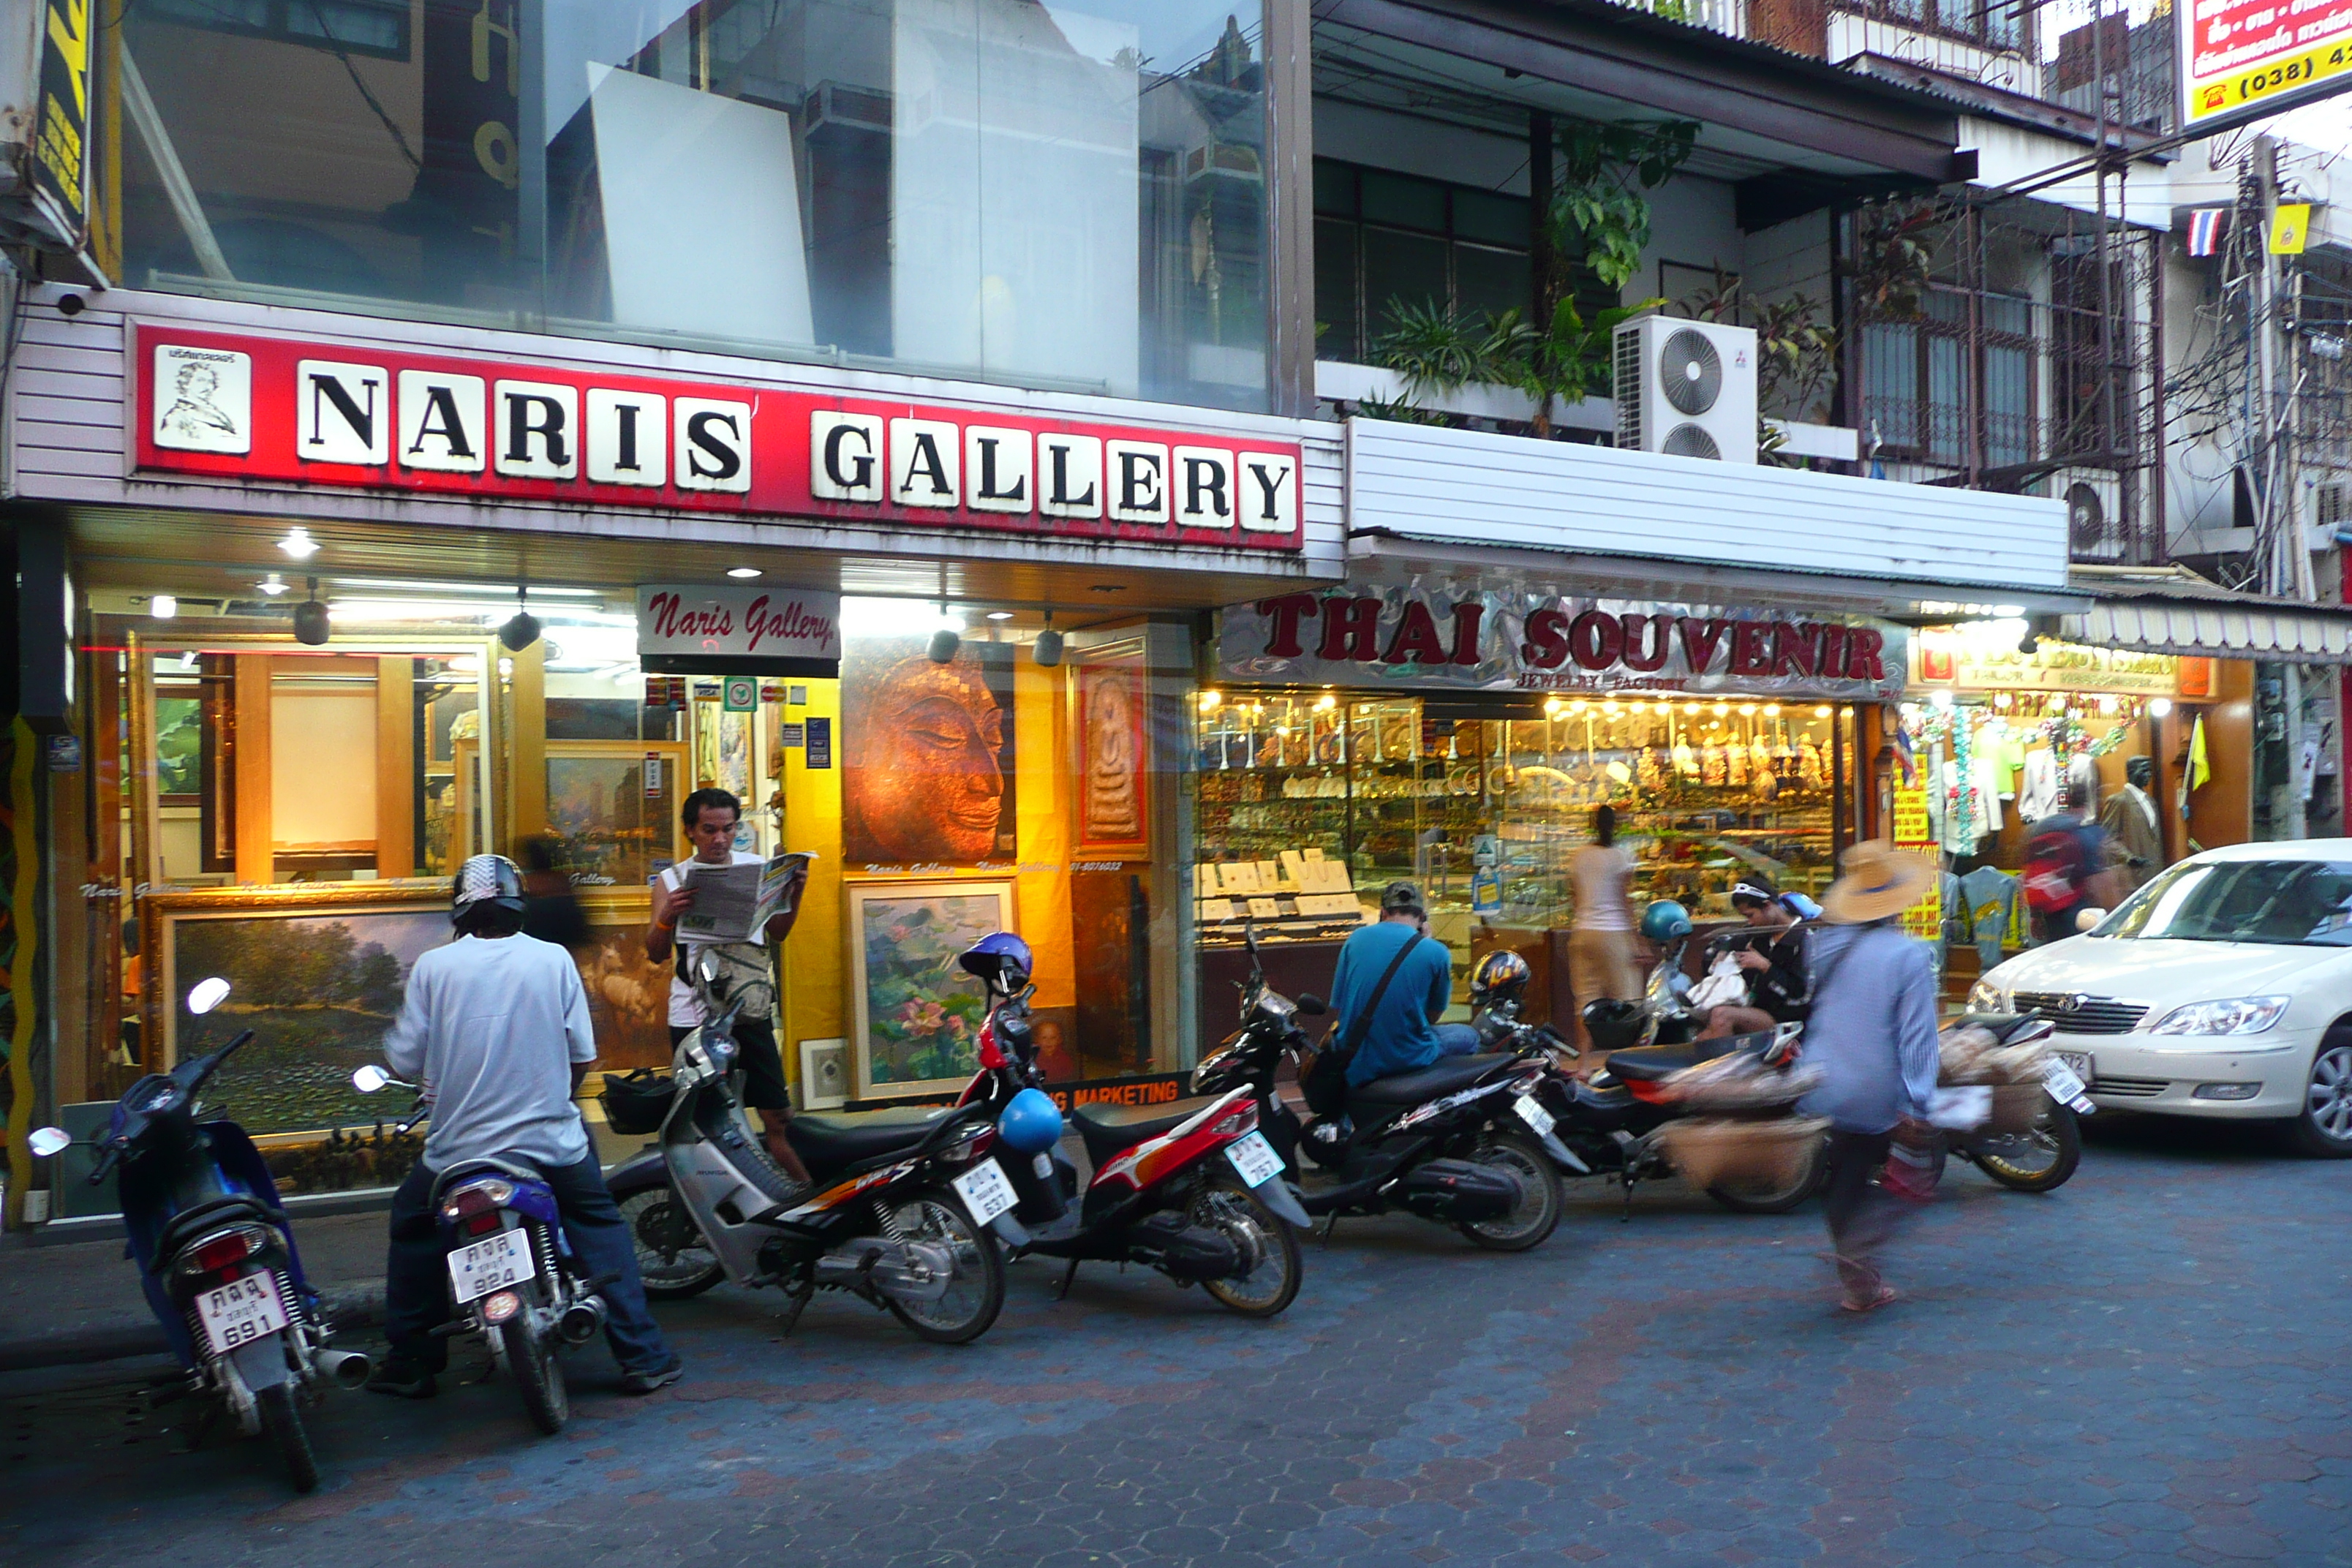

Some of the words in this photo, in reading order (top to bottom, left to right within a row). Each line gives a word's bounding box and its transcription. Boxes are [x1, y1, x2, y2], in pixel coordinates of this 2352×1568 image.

[2240, 57, 2313, 99] (038)
[309, 373, 740, 479] NARIS
[823, 424, 1291, 520] GALLERY
[649, 591, 734, 638] Naris
[745, 595, 834, 652] Gallery
[1259, 593, 1485, 665] THAI
[1521, 608, 1886, 682] SOUVENIR
[1517, 672, 1599, 689] JEWELRY
[1613, 676, 1688, 691] FACTORY
[1073, 1081, 1178, 1107] MARKETING
[474, 1268, 516, 1294] 924
[222, 1314, 271, 1346] 691
